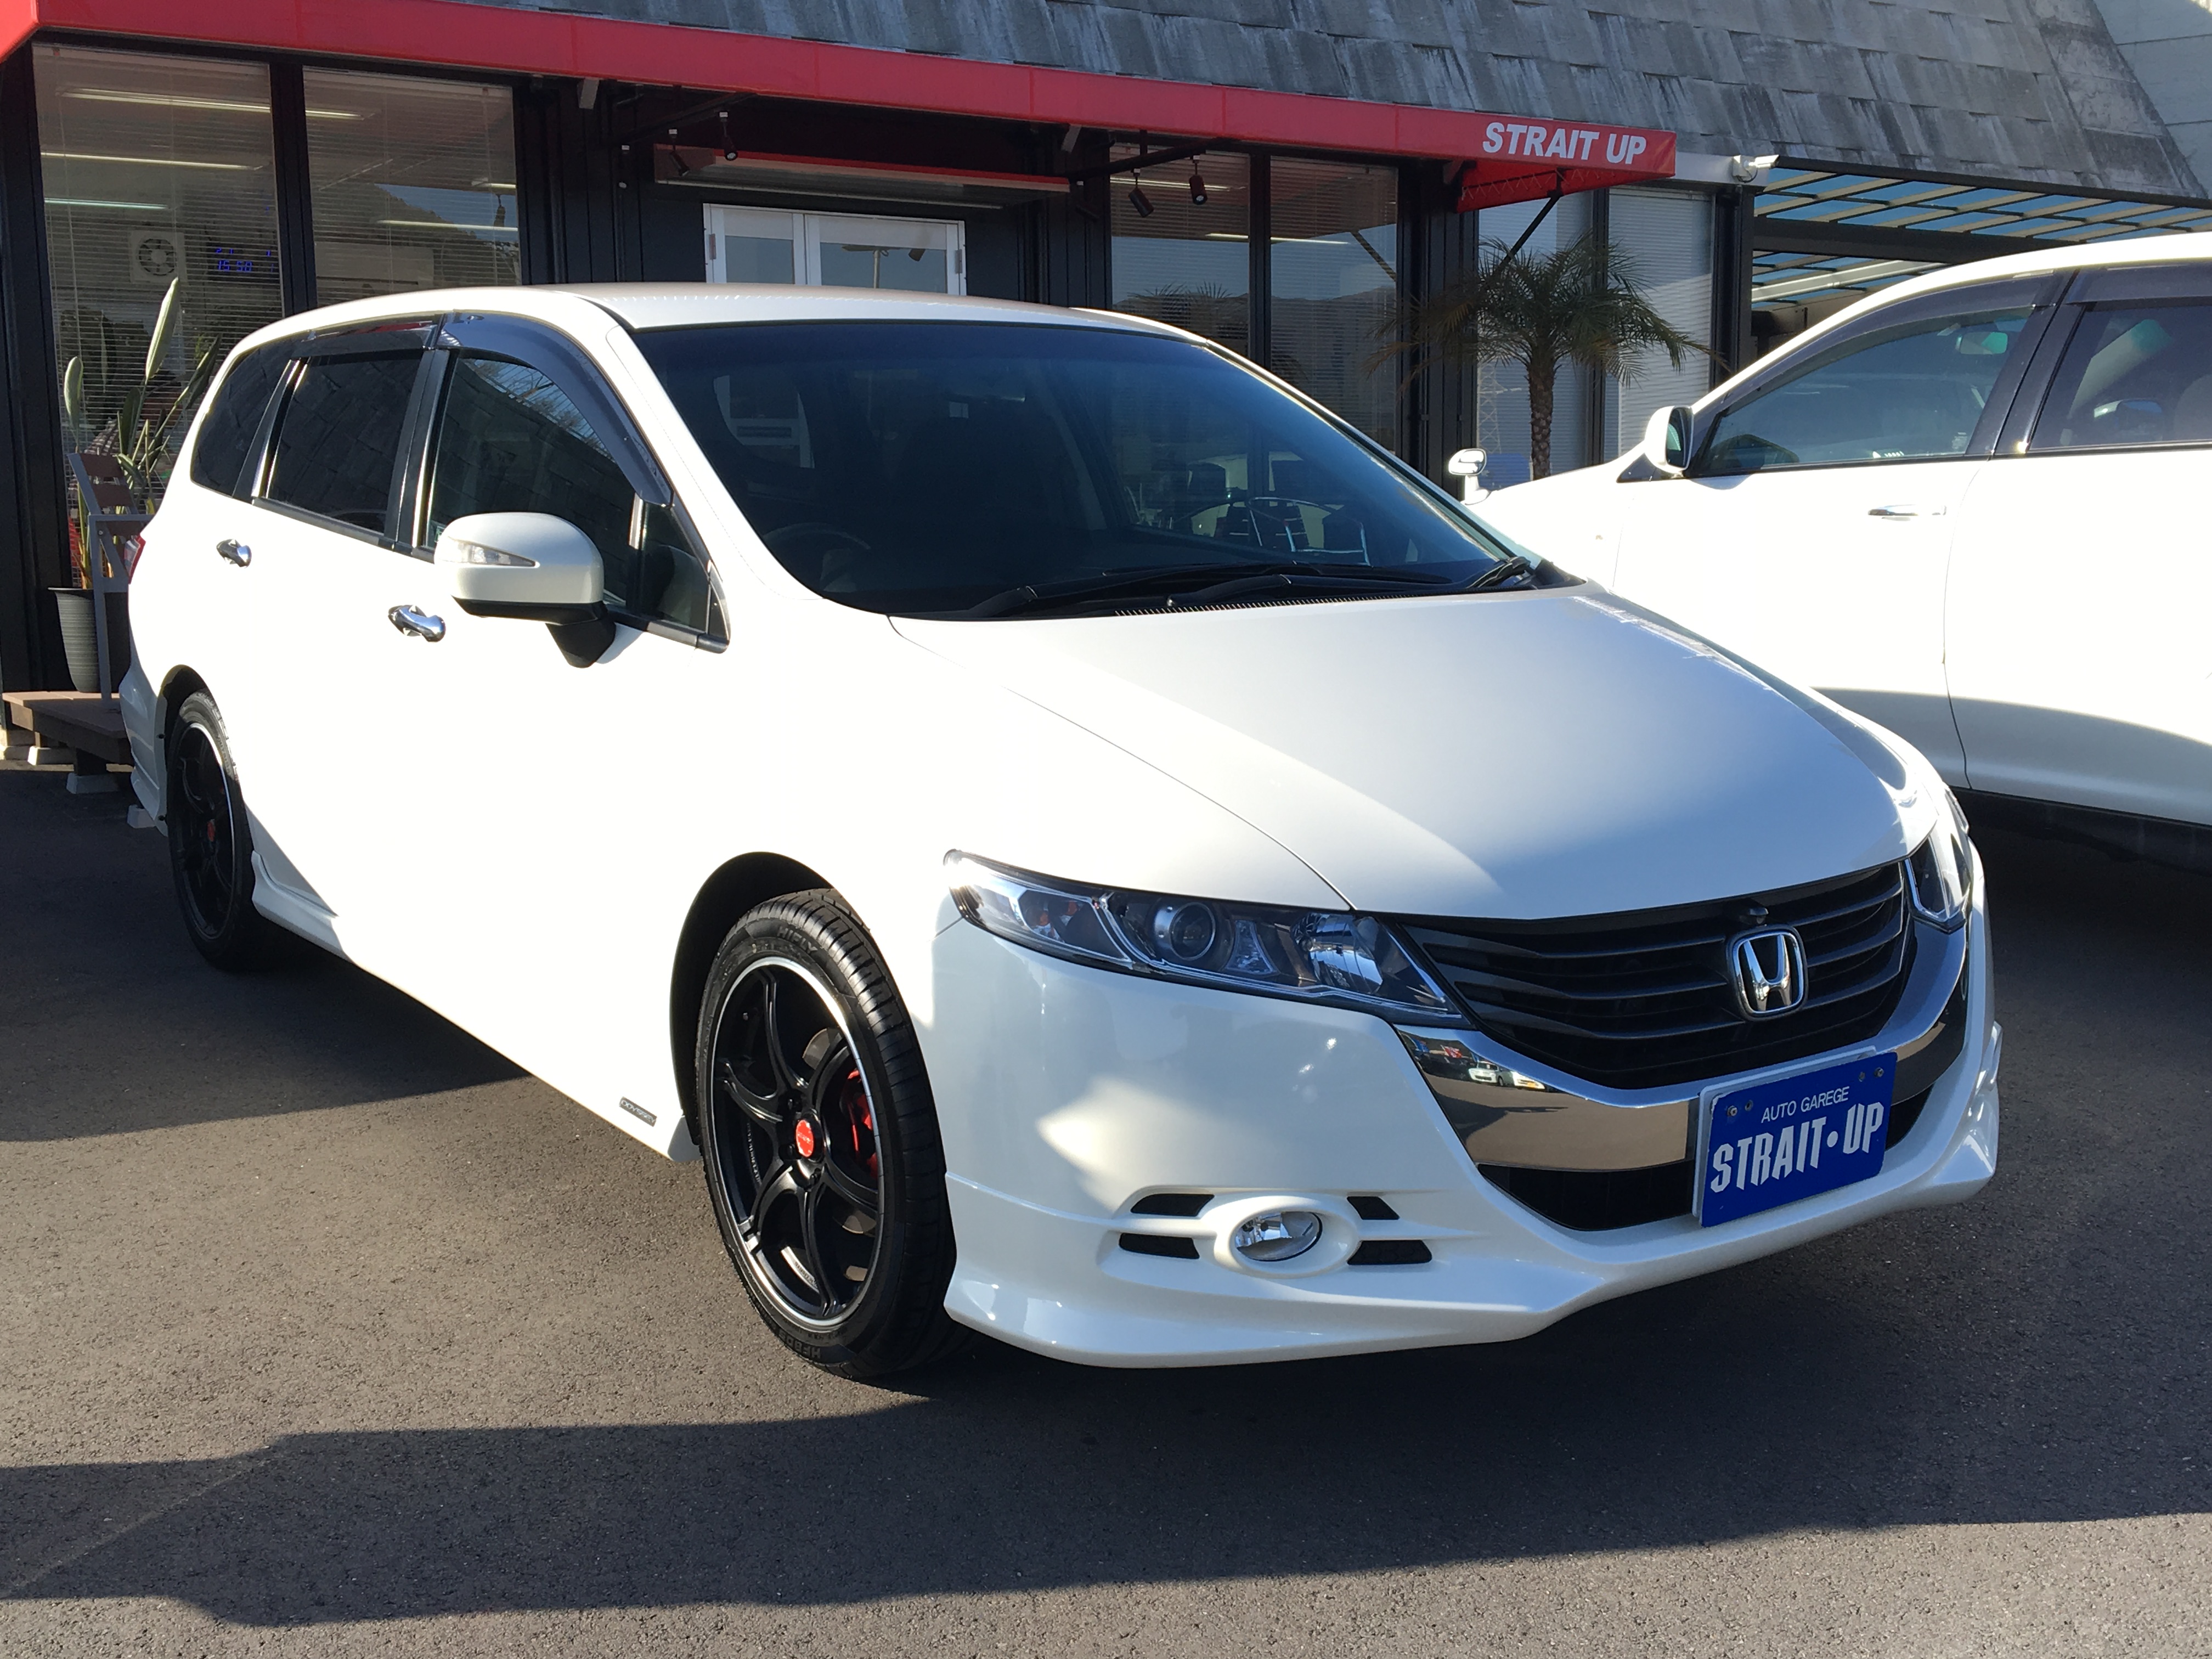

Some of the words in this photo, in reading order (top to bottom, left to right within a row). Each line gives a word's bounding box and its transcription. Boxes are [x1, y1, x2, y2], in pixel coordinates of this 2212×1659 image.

[1483, 122, 1600, 161] STRAIT
[1606, 133, 1647, 165] UP
[1761, 1099, 1797, 1124] AUTO
[1801, 1086, 1849, 1113] GAREGE
